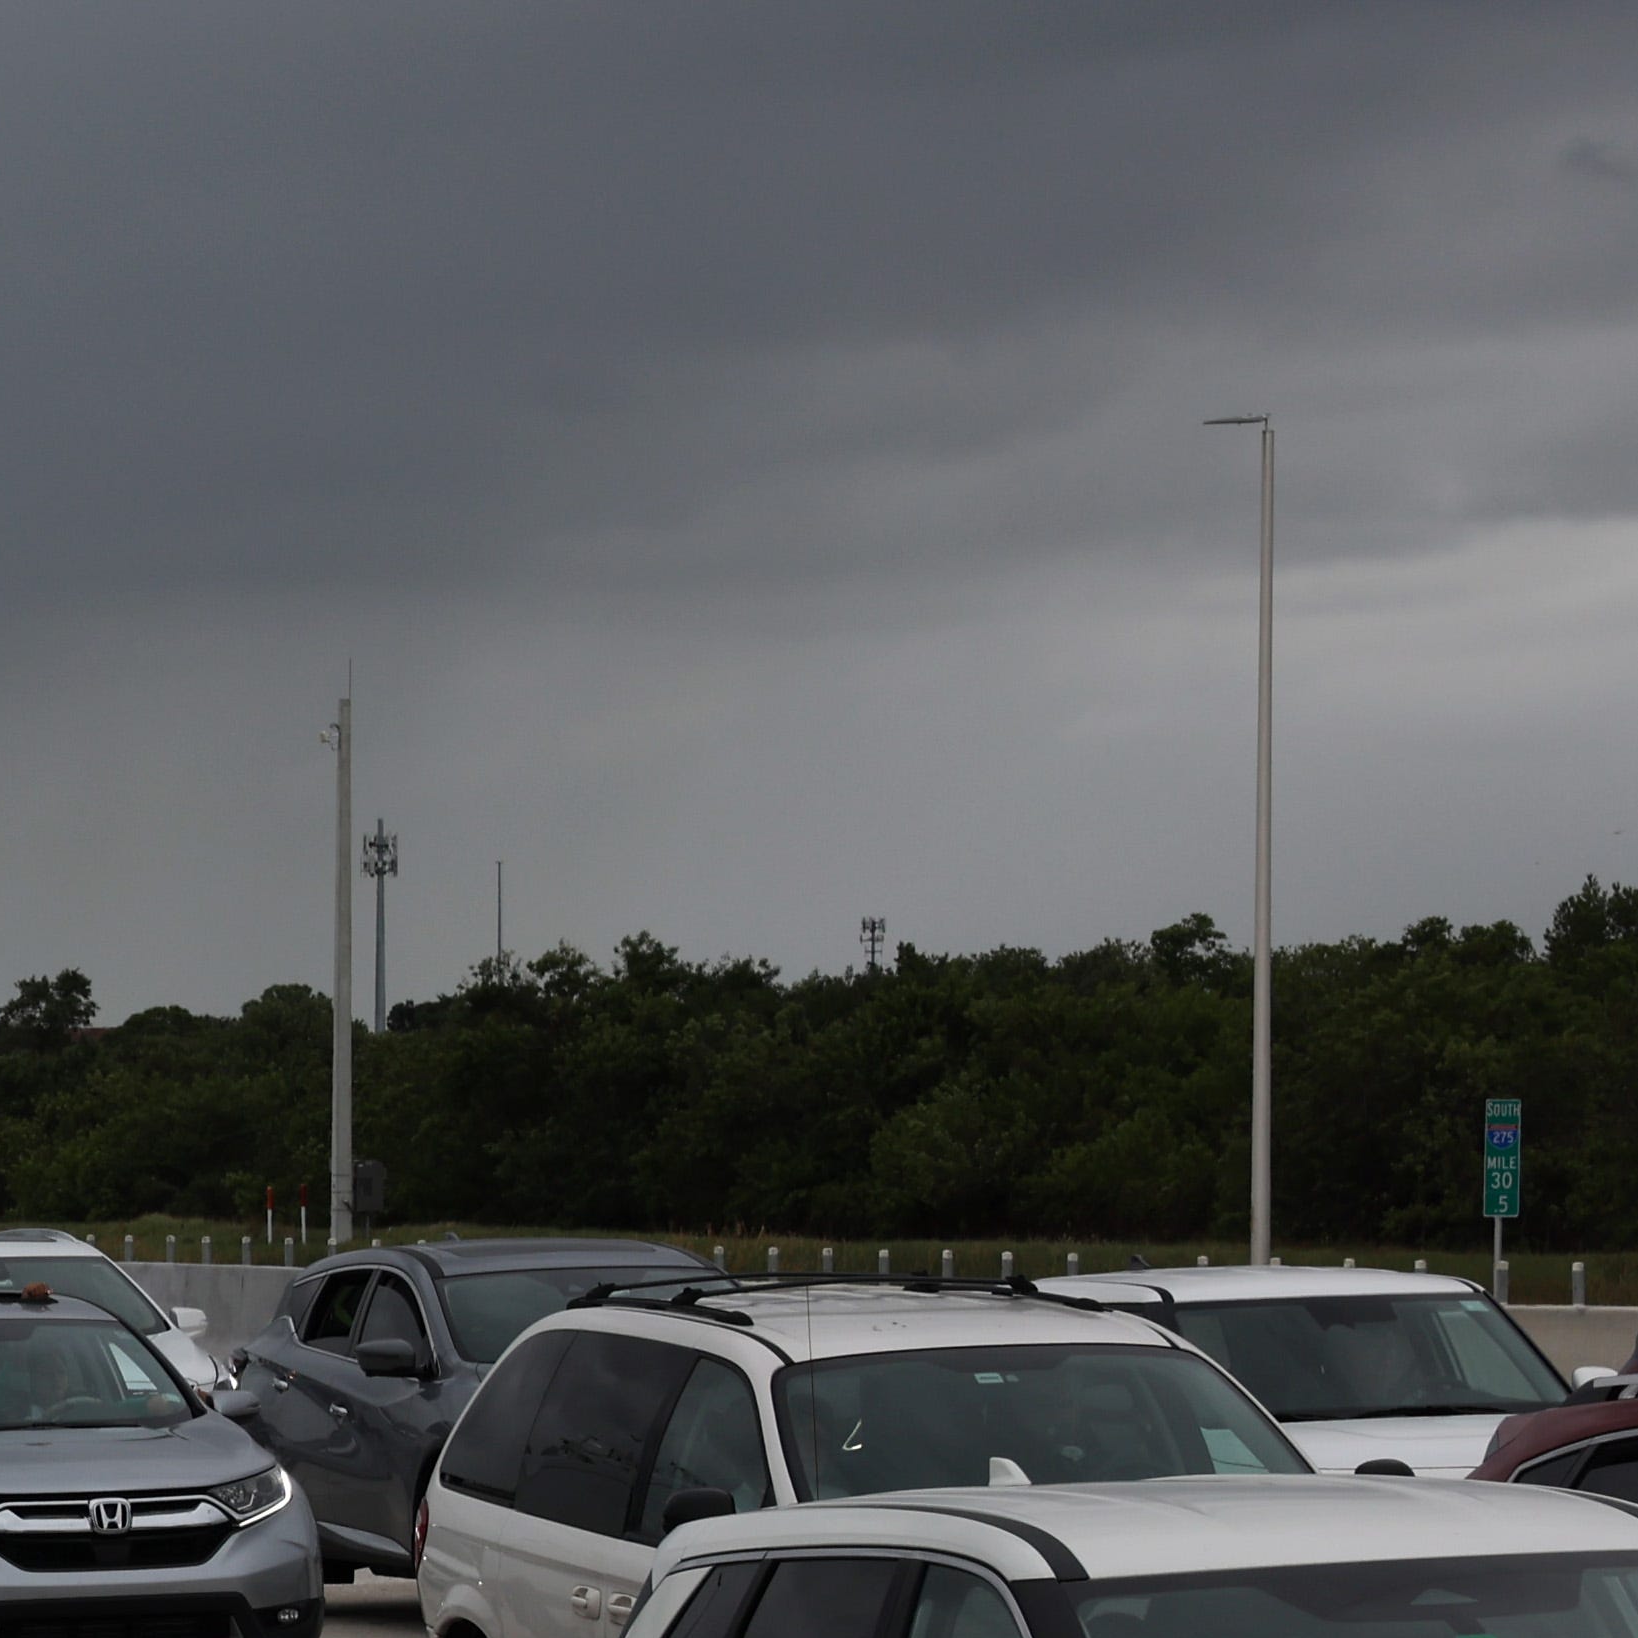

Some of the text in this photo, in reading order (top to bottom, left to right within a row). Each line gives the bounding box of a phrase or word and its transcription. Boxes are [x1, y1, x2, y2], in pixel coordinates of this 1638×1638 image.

[1486, 1102, 1521, 1118] SOUTH
[1492, 1131, 1514, 1144] 275
[1487, 1156, 1517, 1170] MILE
[1491, 1172, 1513, 1189] 30
[1494, 1195, 1509, 1213] .5
